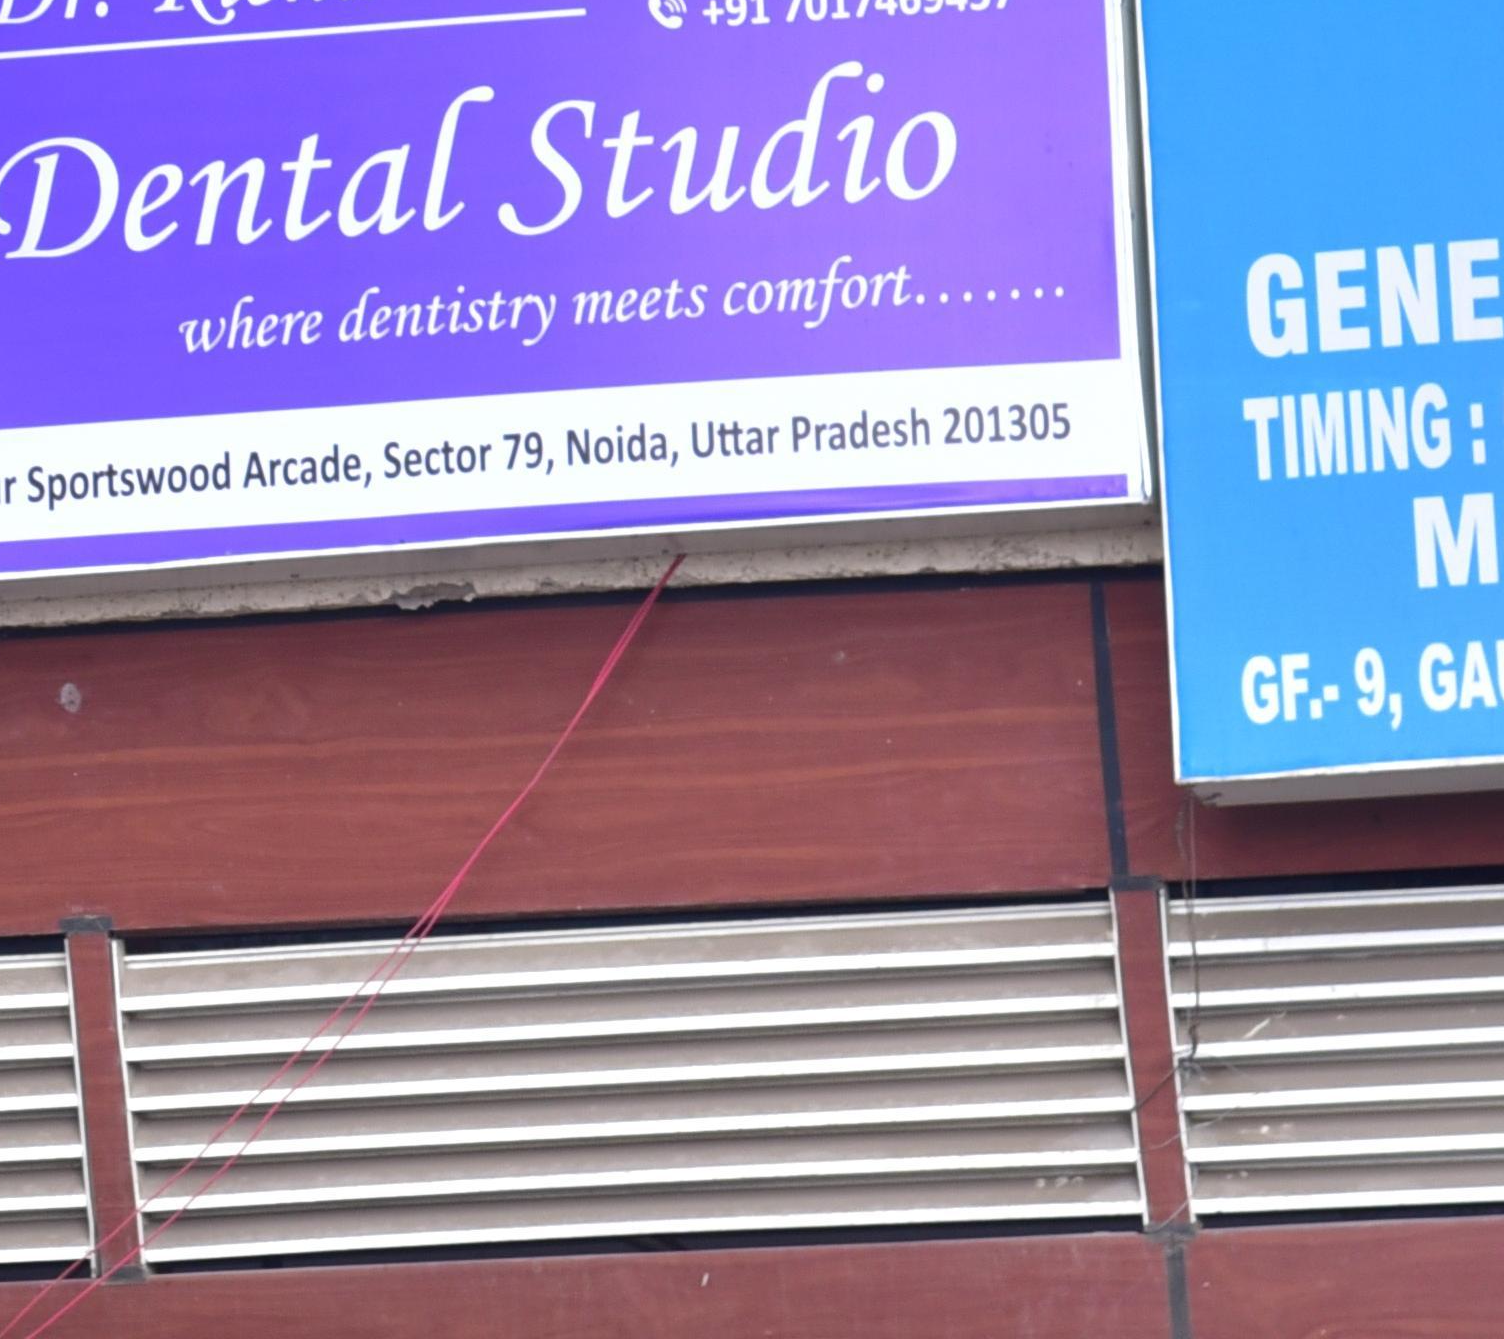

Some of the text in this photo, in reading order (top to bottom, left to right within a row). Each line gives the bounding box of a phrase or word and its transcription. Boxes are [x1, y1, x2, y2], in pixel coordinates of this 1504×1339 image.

[497, 60, 959, 237] Studio
[179, 295, 323, 354] where
[339, 285, 556, 346] dentistry
[573, 284, 708, 328] meets
[28, 451, 230, 504] Sportswood
[243, 443, 371, 488] Arcade,
[384, 440, 491, 479] Sector
[503, 431, 553, 475] 79,
[567, 422, 678, 467] Noida,
[692, 421, 779, 458] Uttar
[792, 407, 930, 453] Pradesh
[944, 402, 1070, 444] 201305
[1243, 382, 1451, 481] TIMING
[1354, 647, 1402, 725] 9,
